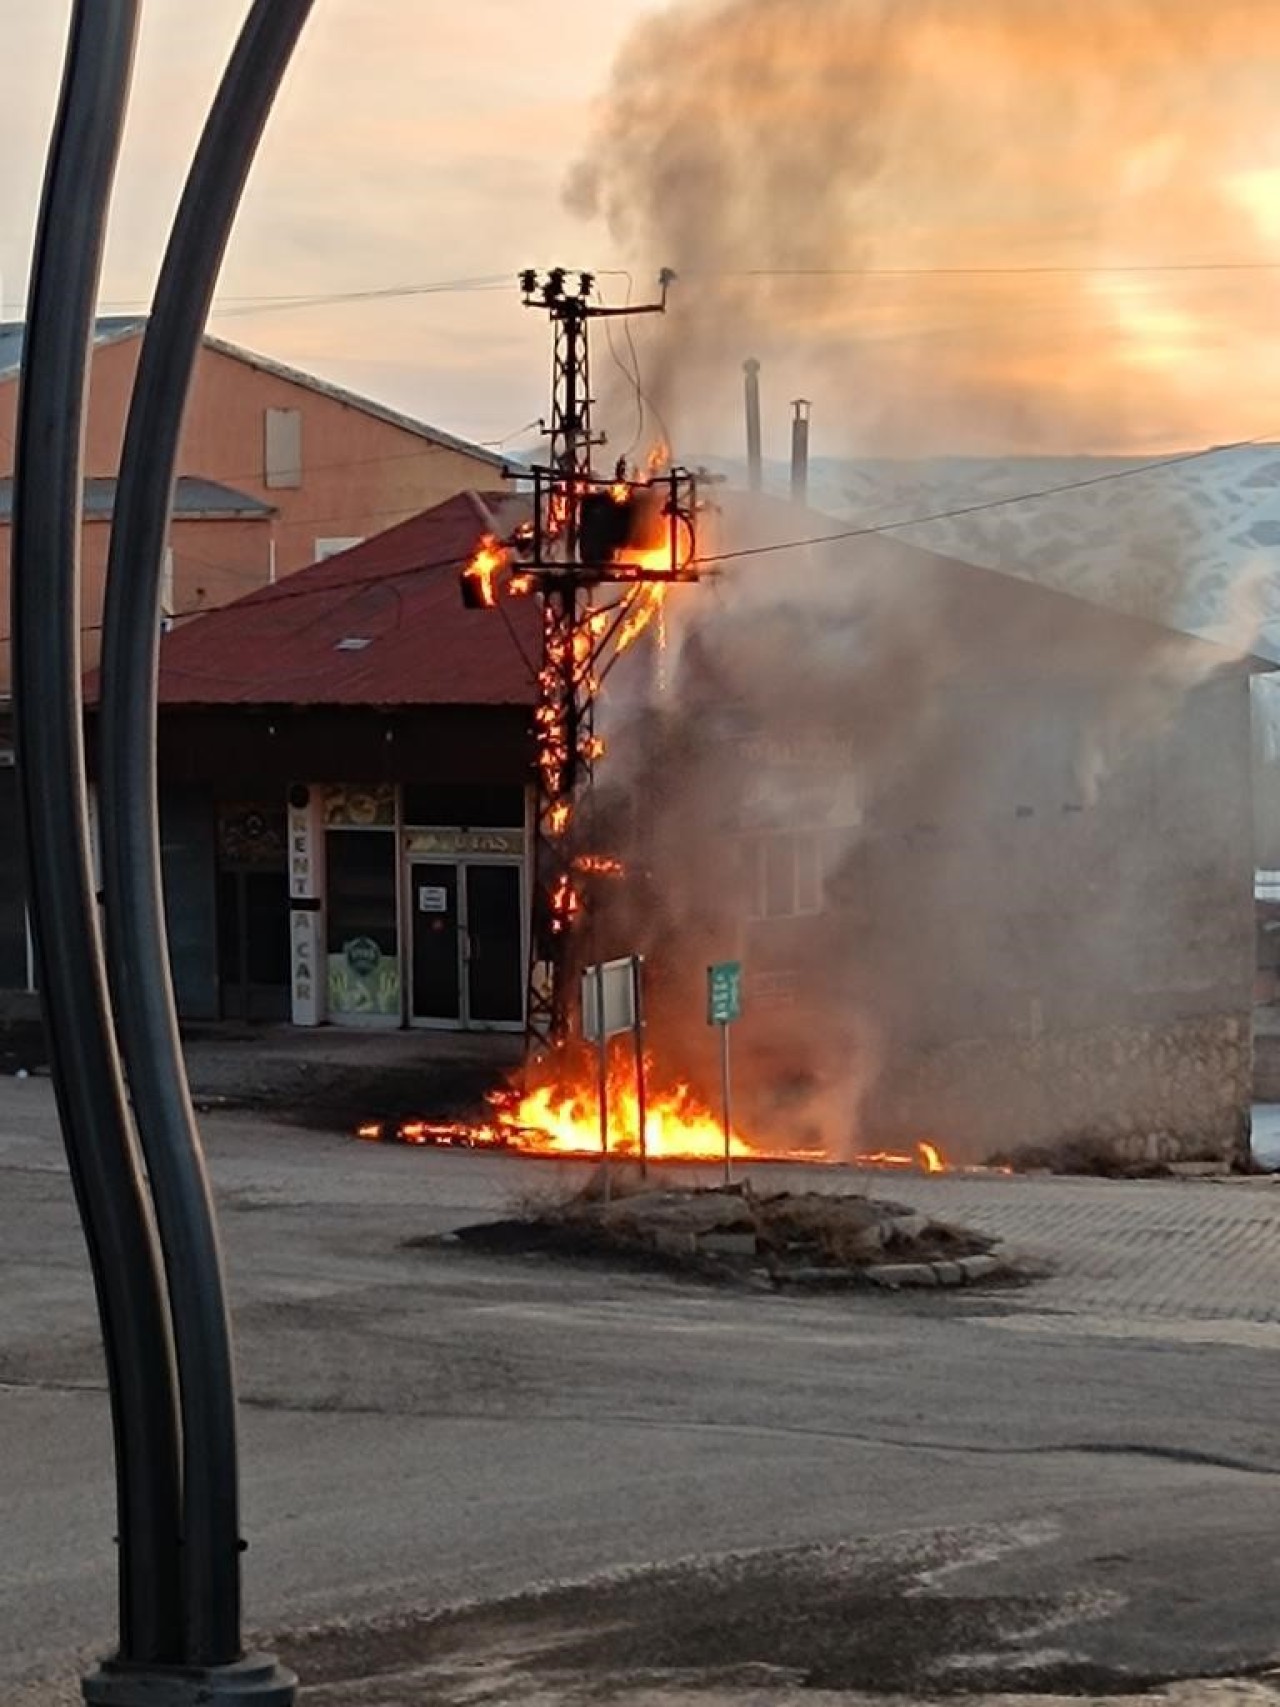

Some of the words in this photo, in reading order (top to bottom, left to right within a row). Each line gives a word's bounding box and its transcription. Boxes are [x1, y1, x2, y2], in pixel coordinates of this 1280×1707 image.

[293, 814, 309, 894] RENT
[294, 913, 310, 929] A
[296, 942, 311, 1000] CAR
